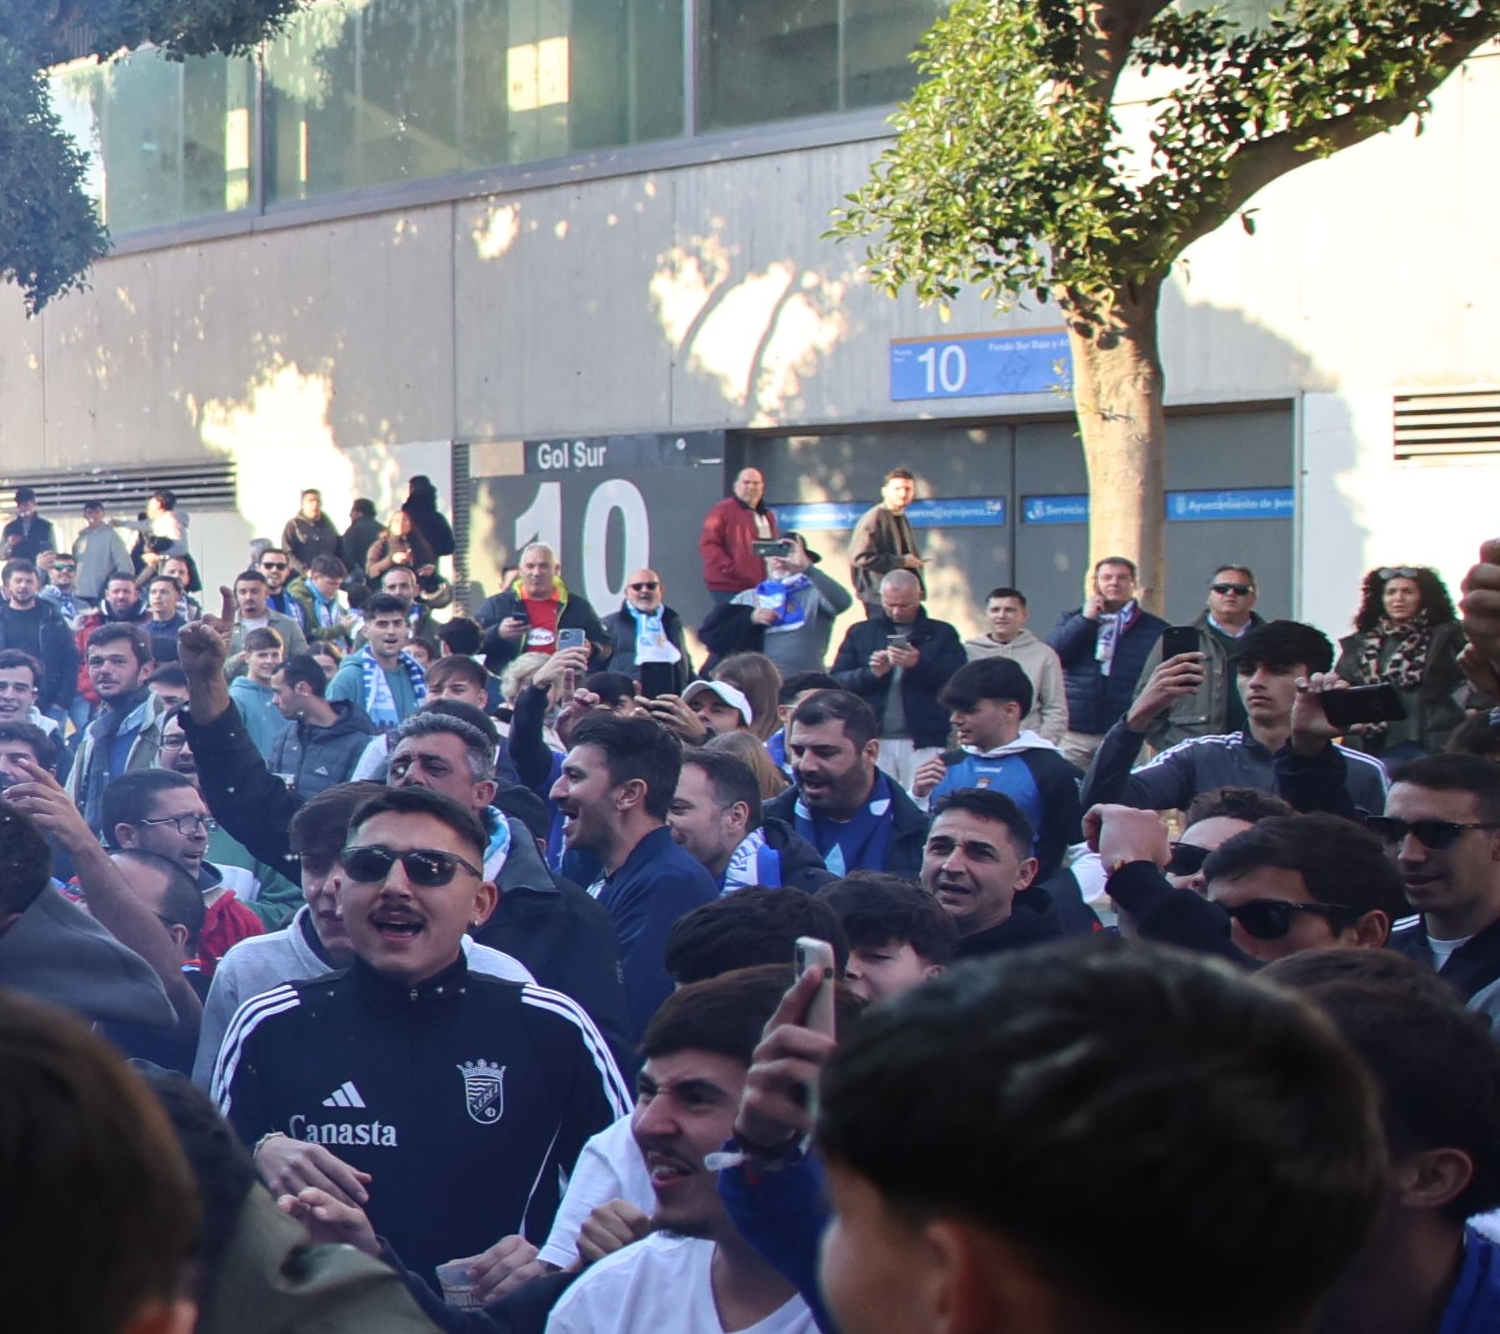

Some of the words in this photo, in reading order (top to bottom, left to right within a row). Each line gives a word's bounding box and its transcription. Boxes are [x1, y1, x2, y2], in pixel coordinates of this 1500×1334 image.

[916, 344, 967, 394] 10
[537, 441, 569, 470] Gol
[573, 440, 607, 469] Sur
[514, 478, 650, 618] 10
[288, 1114, 399, 1147] Canasta
